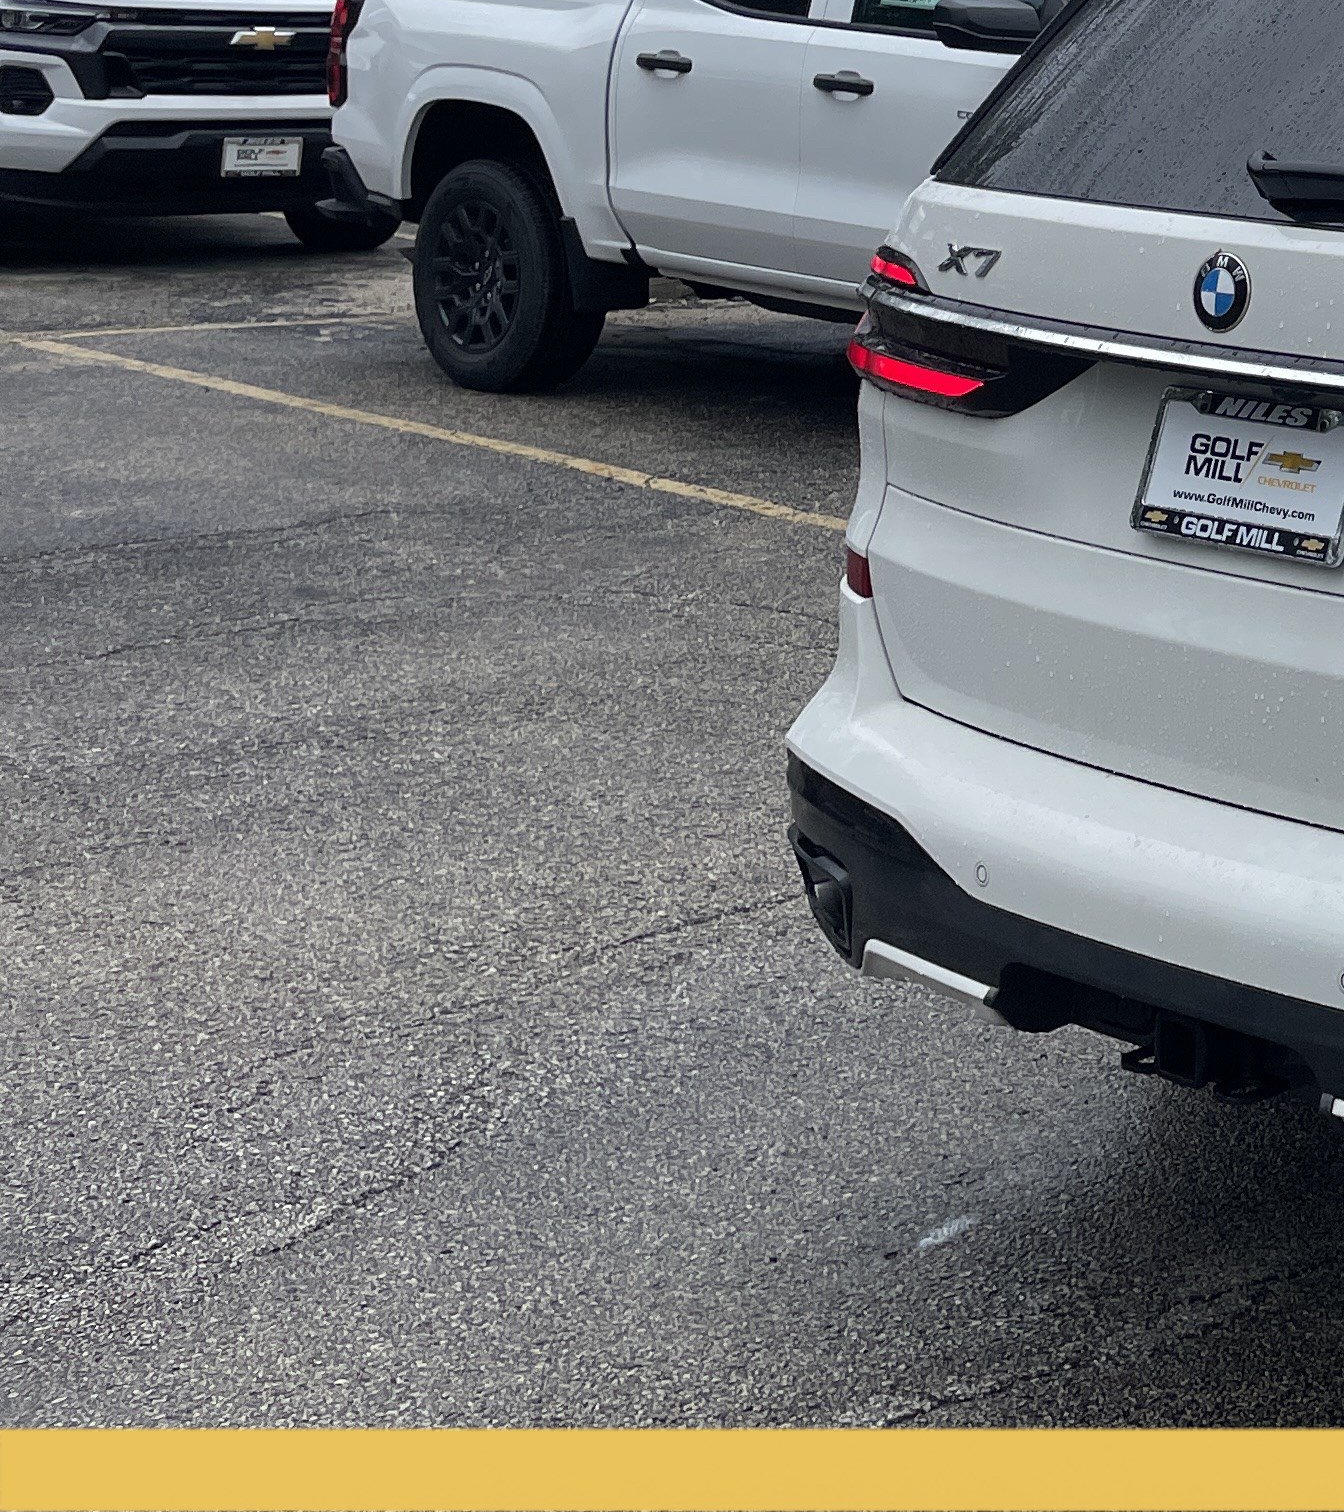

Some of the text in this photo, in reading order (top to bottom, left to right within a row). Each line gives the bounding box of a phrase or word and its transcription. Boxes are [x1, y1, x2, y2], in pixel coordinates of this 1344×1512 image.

[937, 243, 1002, 278] X7
[1198, 255, 1246, 282] BMW
[1215, 396, 1313, 426] NILES
[1189, 432, 1265, 462] GOLF
[1184, 454, 1244, 482] MILL
[1257, 476, 1317, 494] CHEVROLET
[1172, 489, 1315, 522] www.GolfMillChevy.com
[1180, 516, 1285, 552] GOLF MILL
